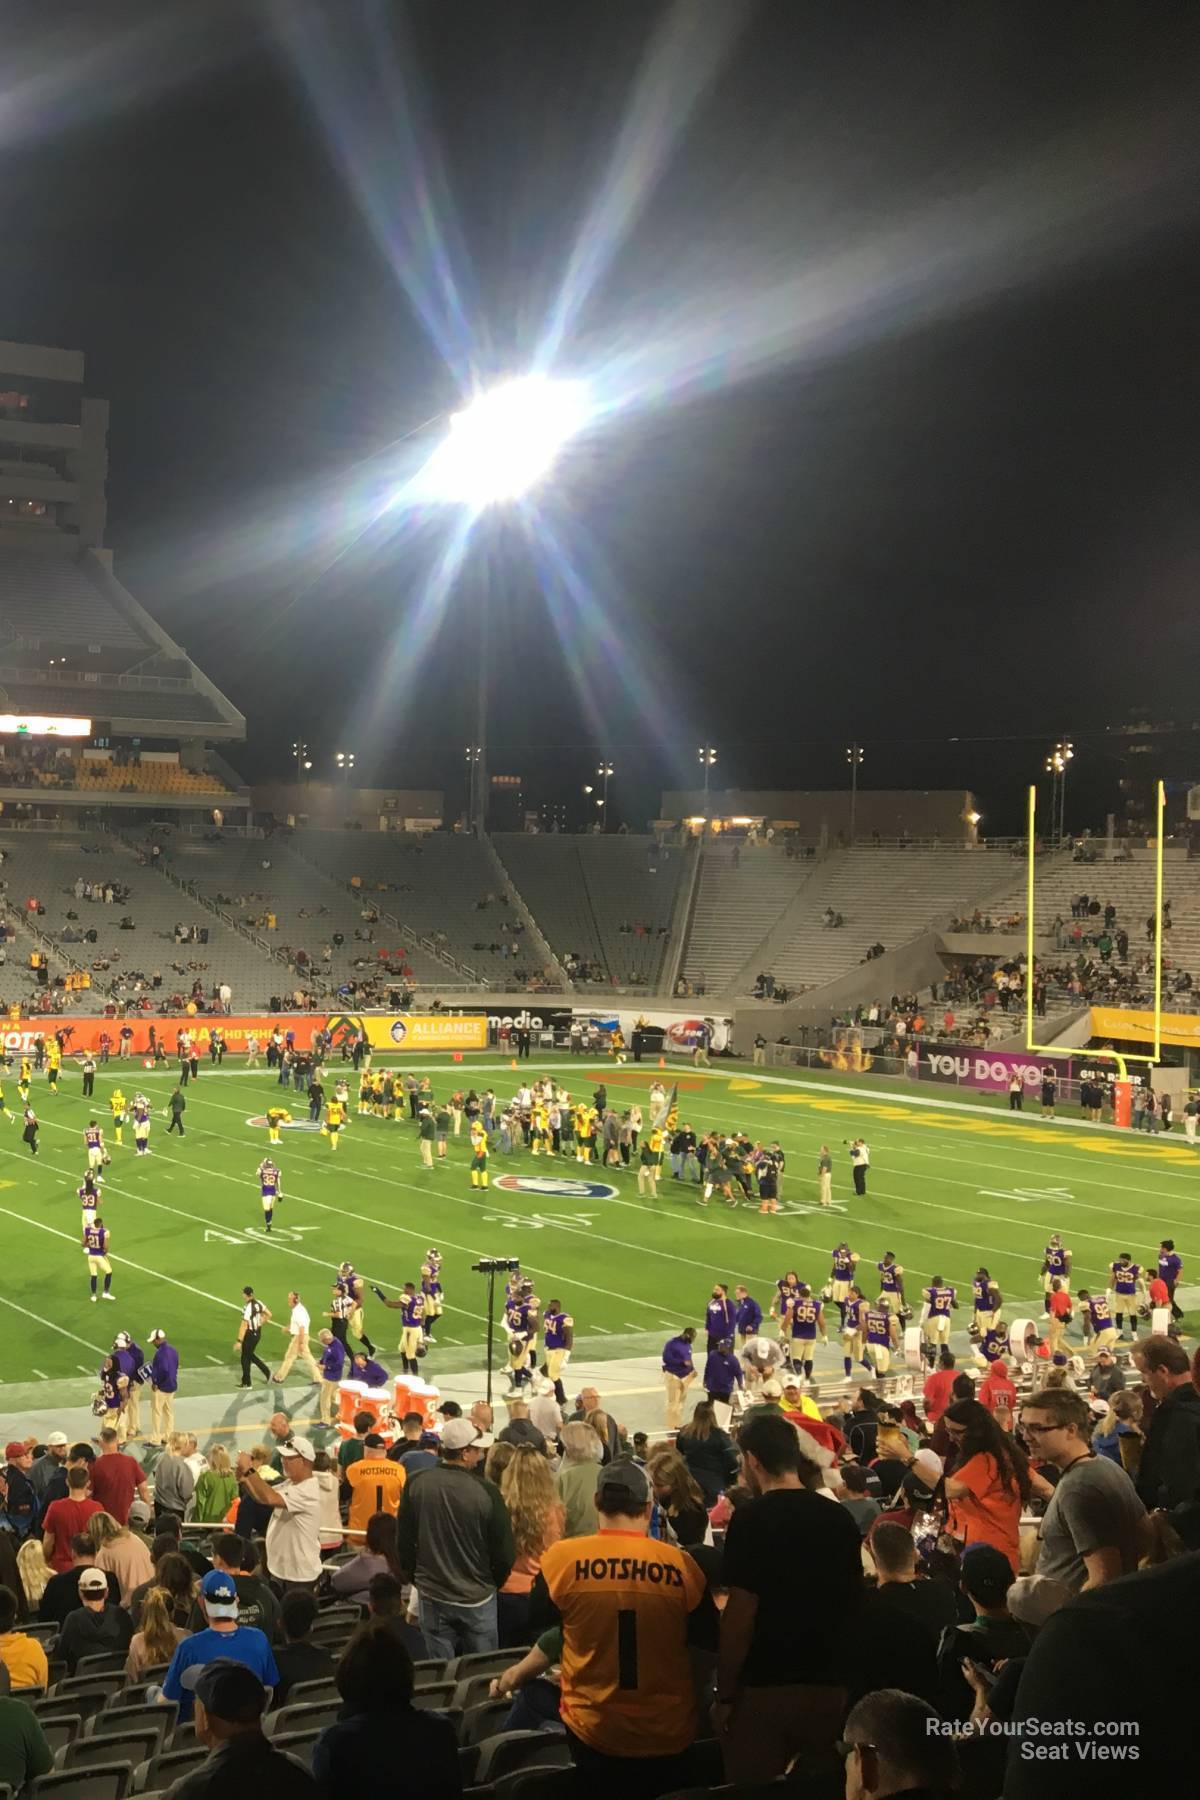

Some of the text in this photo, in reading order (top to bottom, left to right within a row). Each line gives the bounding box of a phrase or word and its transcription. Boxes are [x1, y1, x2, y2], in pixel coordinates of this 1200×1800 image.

[412, 1022, 481, 1034] ALLIANCE
[927, 1053, 970, 1078] YOU
[975, 1060, 1007, 1082] DO
[360, 1466, 398, 1477] HOTSHOTS
[575, 1557, 683, 1587] HOTSHOTS
[617, 1609, 638, 1690] 1
